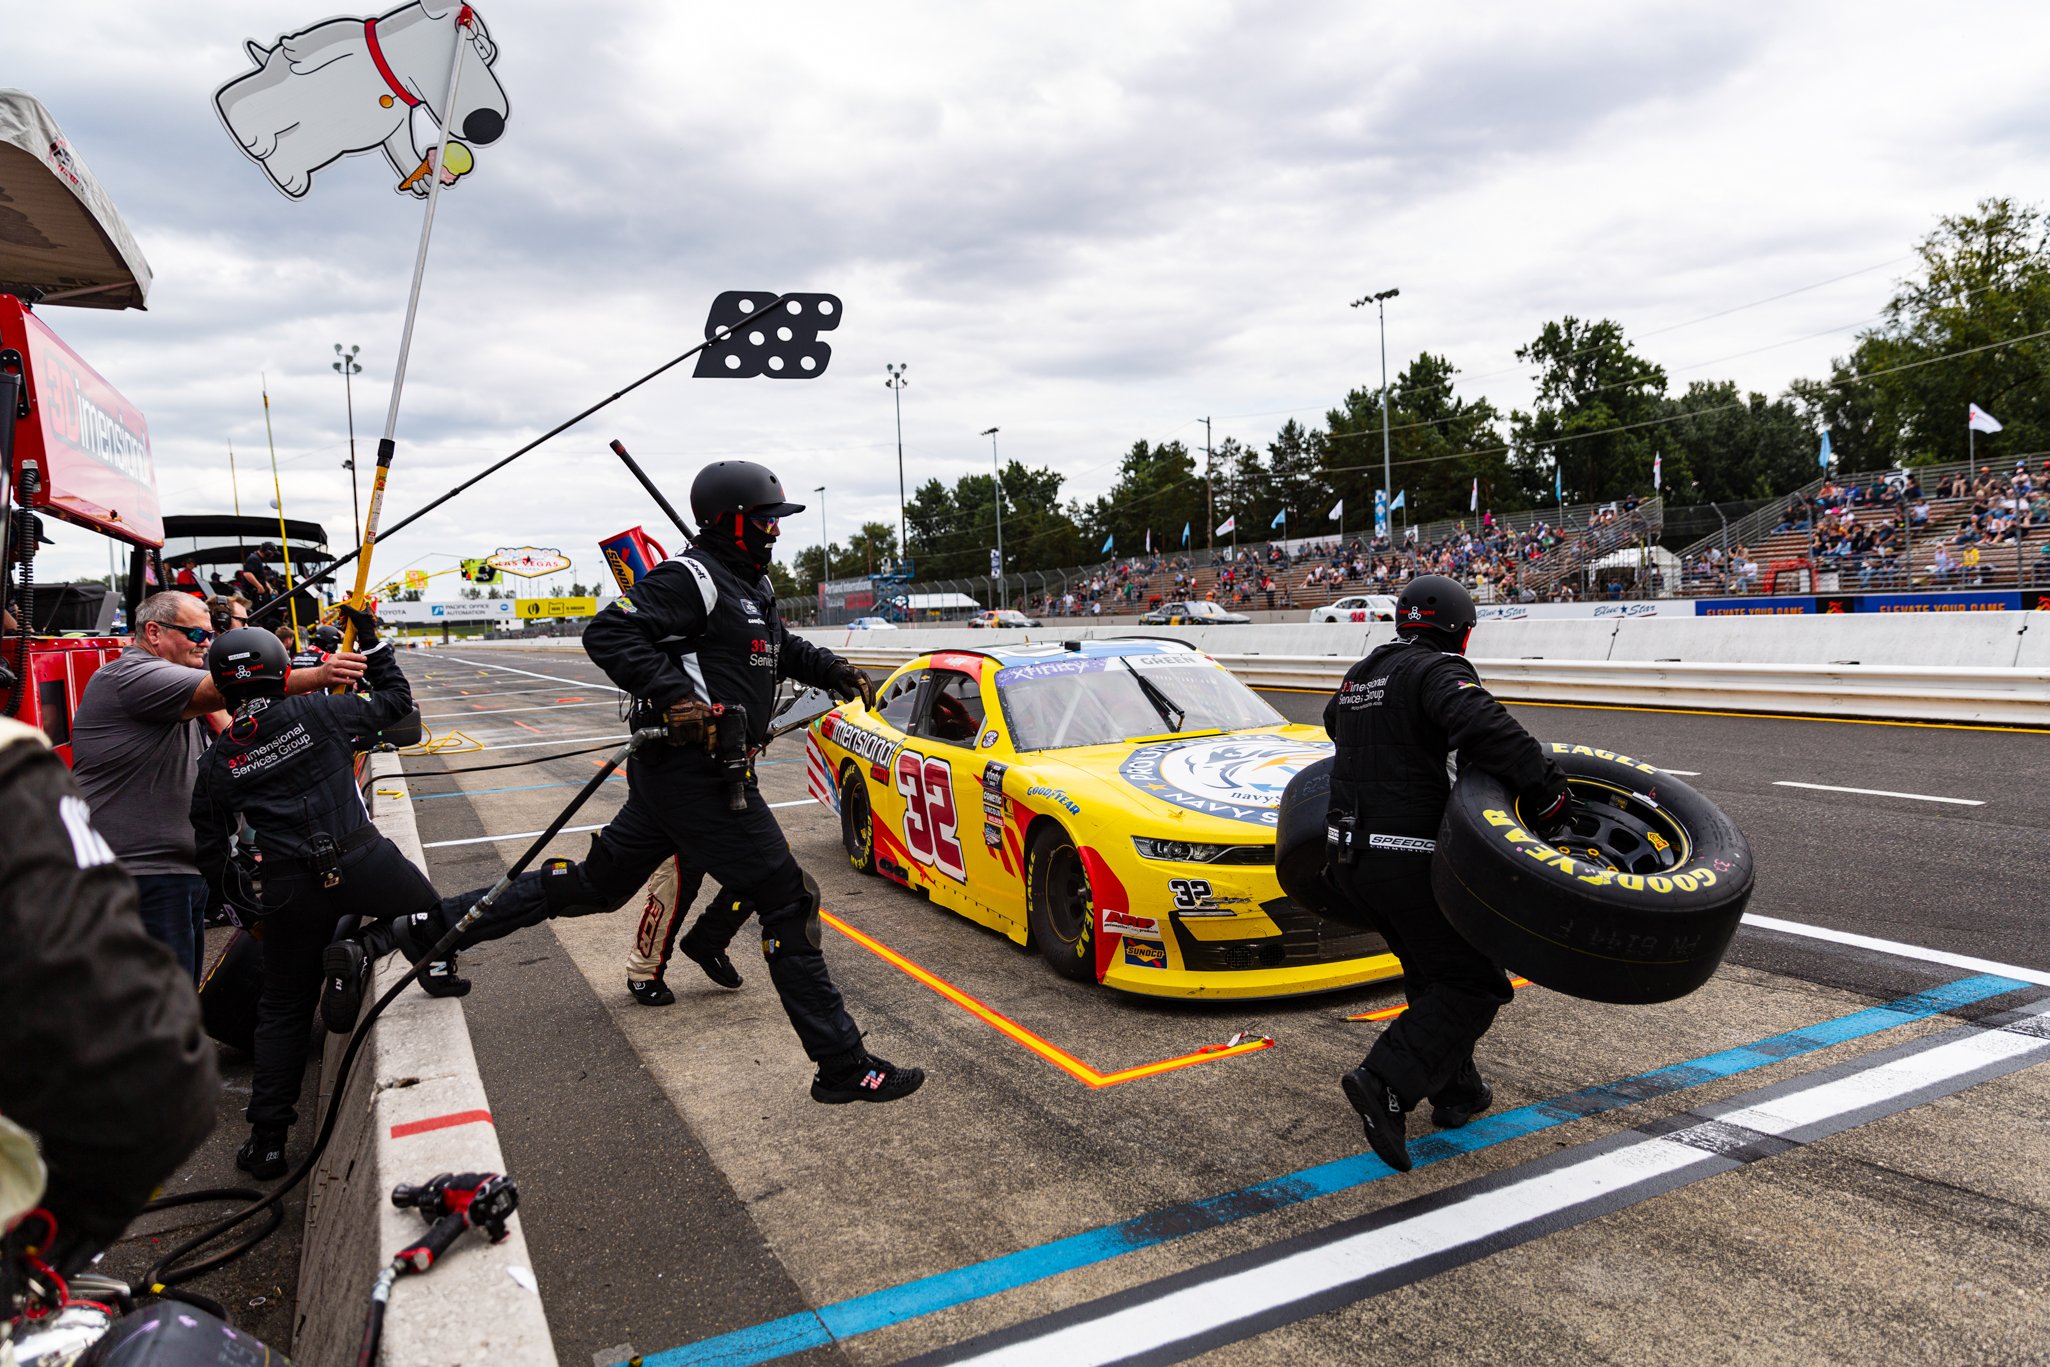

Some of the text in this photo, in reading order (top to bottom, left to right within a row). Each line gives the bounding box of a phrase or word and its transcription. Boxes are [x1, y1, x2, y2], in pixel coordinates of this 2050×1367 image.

[1477, 607, 1527, 618] Blue Star
[1593, 604, 1656, 617] Blue Star
[1140, 656, 1196, 666] GREEN
[231, 751, 279, 778] Services
[277, 733, 311, 755] Group
[1126, 745, 1171, 781] PROUD
[1550, 742, 1660, 775] EAGLE
[1026, 786, 1081, 816] GOODYEAR
[1164, 793, 1254, 819] NAVY
[895, 750, 967, 884] 32
[1482, 809, 1717, 894] GOODYEAR
[1027, 851, 1036, 912] EAGLE
[1168, 879, 1218, 910] 32
[1104, 911, 1156, 929] ARP
[1127, 947, 1164, 958] SUNOCO
